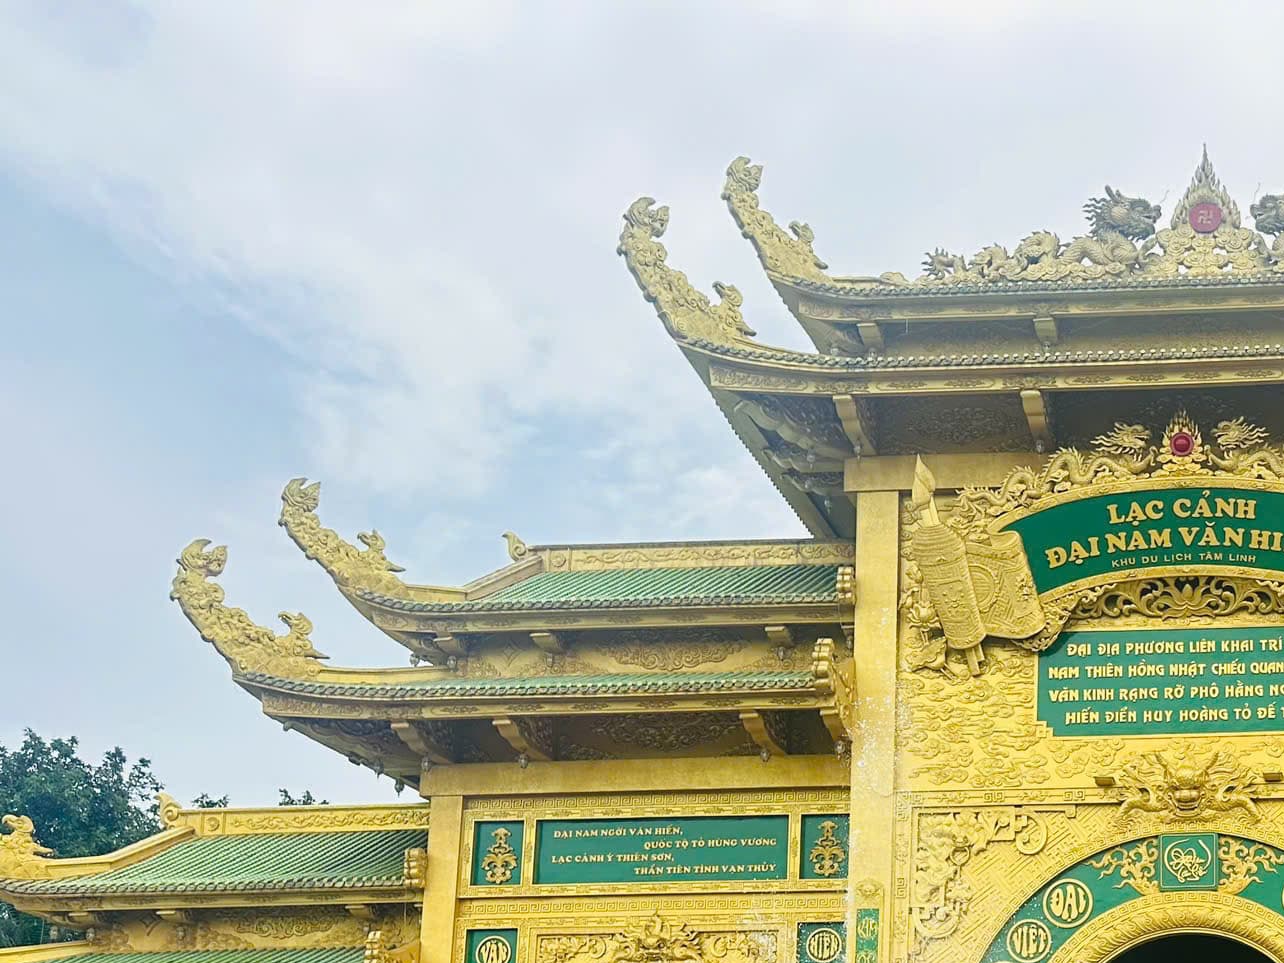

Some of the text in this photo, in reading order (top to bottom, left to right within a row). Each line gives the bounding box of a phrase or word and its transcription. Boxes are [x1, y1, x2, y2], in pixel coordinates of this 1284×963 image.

[1108, 490, 1256, 525] LẠC CẢNH
[1046, 537, 1099, 568] ĐẠI
[1106, 529, 1171, 552] NAM
[1179, 522, 1243, 546] VĂN
[1112, 559, 1135, 567] KHU
[1067, 644, 1091, 657] ĐẠI
[1098, 644, 1119, 656] ĐỊA
[1126, 641, 1184, 654] PHƯƠNG
[1190, 639, 1215, 652] LIÊN
[1222, 640, 1253, 652] KHAI
[1260, 636, 1282, 651] TRÍ
[1049, 667, 1079, 679] NAM
[1085, 663, 1122, 678] THIÊN
[1128, 659, 1164, 677] HỒNG
[1170, 661, 1206, 677] NHẬT
[1211, 659, 1245, 675] CHIẾU
[1049, 687, 1079, 702] VĂN
[1084, 689, 1114, 700] KINH
[1120, 688, 1158, 702] RẠNG
[1164, 685, 1184, 699] RỠ
[1066, 707, 1099, 724] HIẾN
[1144, 711, 1172, 722] HUY
[1180, 706, 1228, 721] HOÀNG
[1048, 884, 1088, 923] ĐẠI
